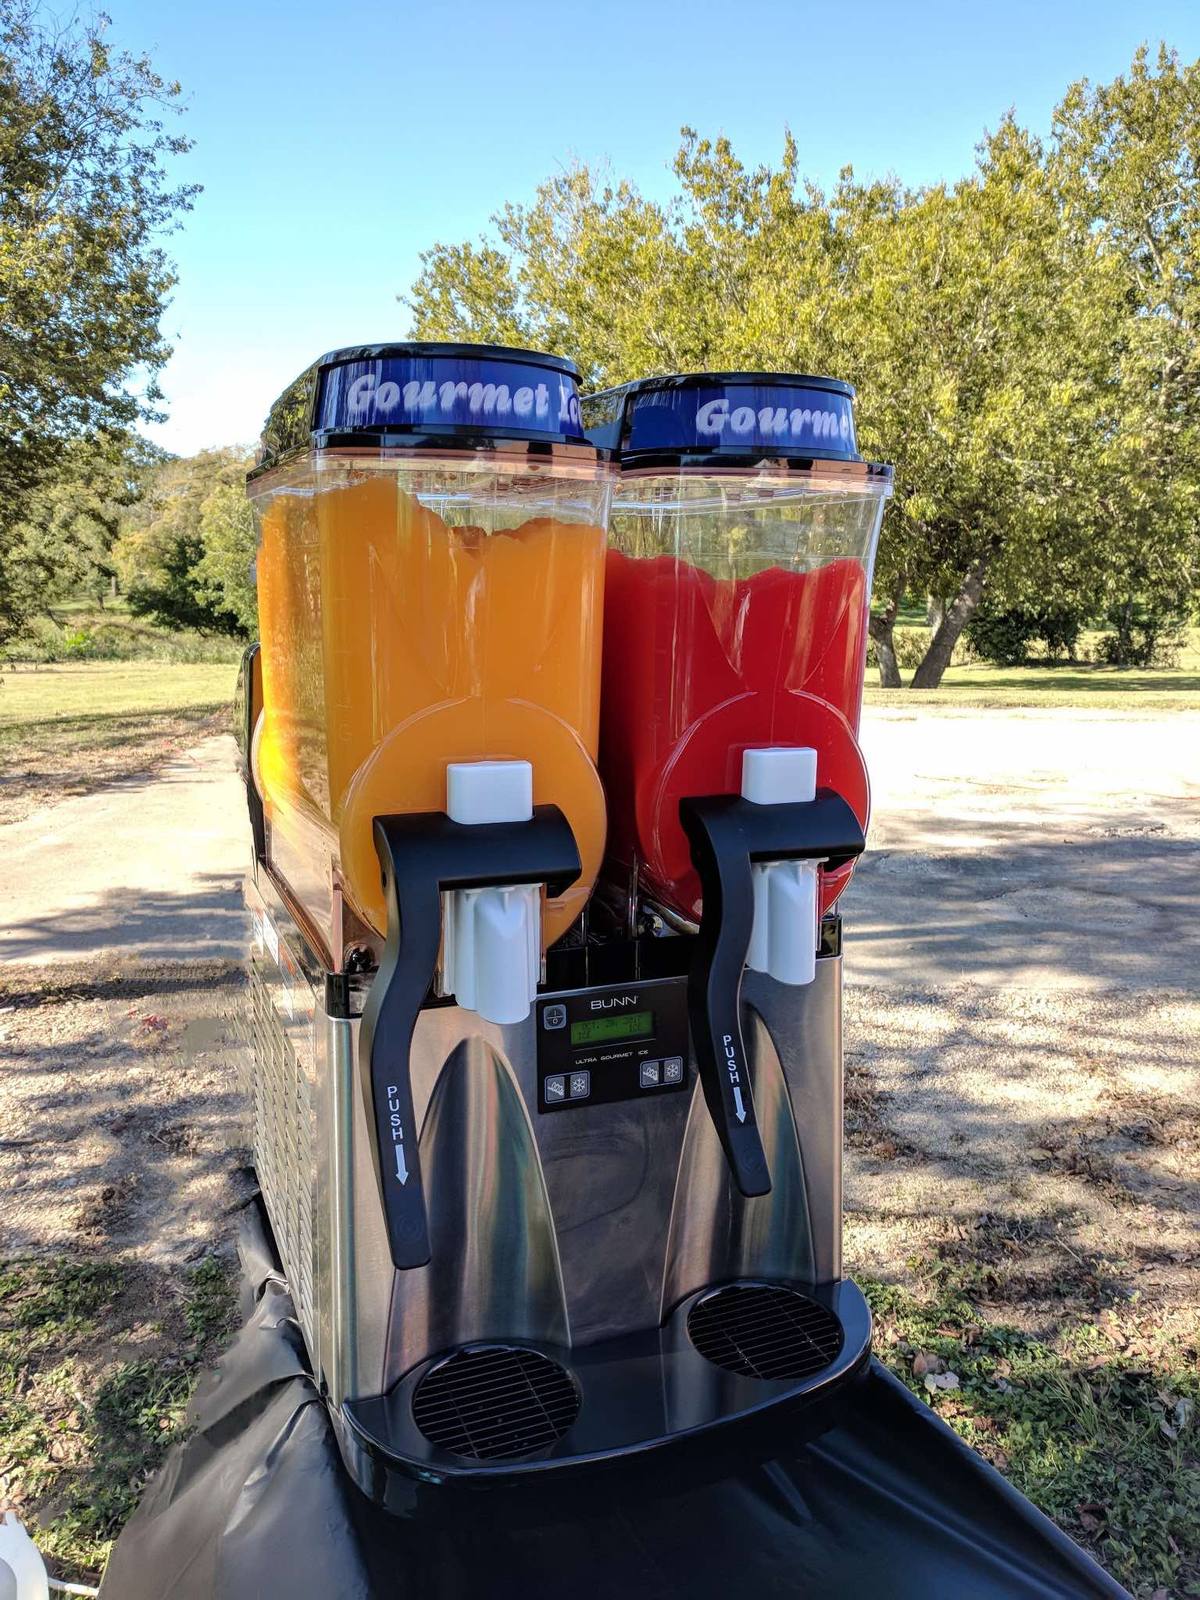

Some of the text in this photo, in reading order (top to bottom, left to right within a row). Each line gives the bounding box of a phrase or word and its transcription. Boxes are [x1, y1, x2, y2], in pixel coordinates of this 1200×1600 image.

[348, 373, 549, 418] Gourmet
[590, 995, 637, 1010] BUNN
[575, 1056, 598, 1065] ULTRA
[600, 1051, 633, 1061] GOURMET
[723, 1034, 740, 1084] PUSH
[387, 1085, 404, 1141] PUSH
